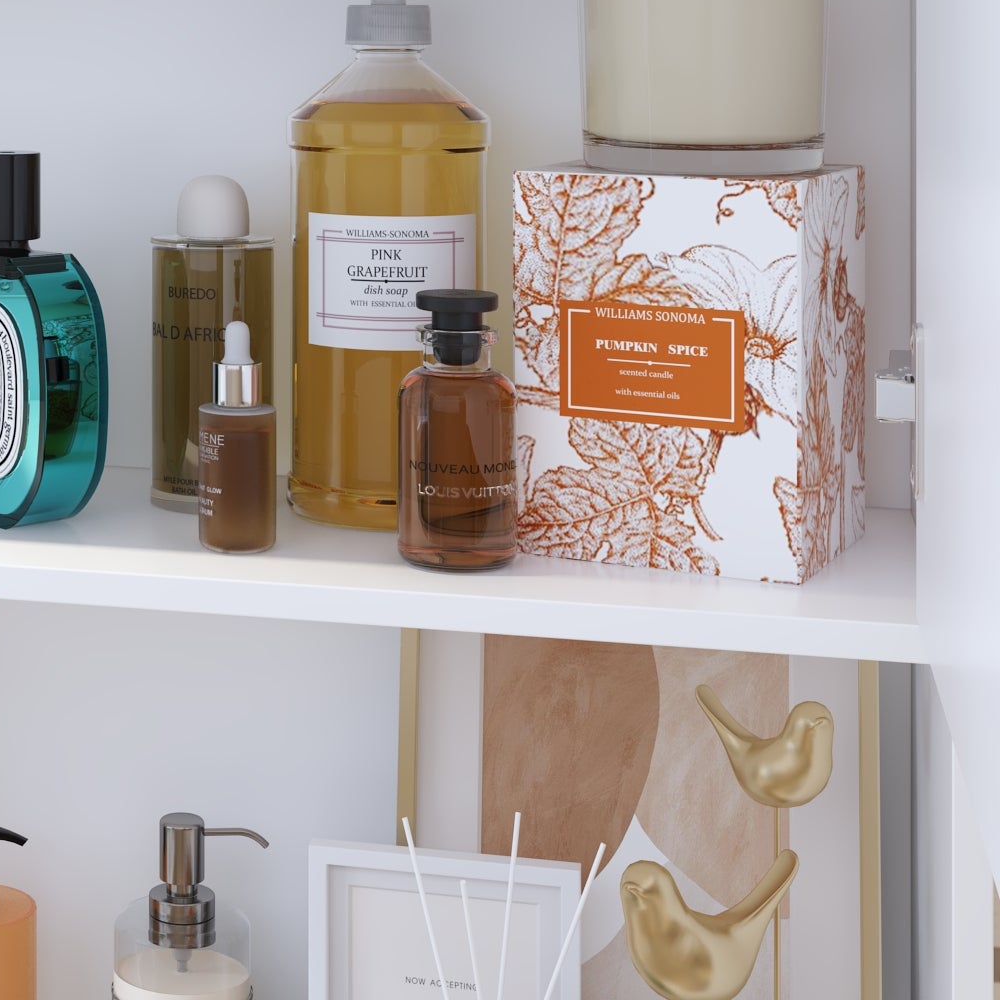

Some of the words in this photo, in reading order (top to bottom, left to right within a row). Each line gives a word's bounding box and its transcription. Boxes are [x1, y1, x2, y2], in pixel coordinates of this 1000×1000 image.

[345, 228, 430, 239] WILLIAMS-SONOMA
[371, 249, 403, 260] PINK
[347, 265, 428, 278] GRAPEFRUIT
[364, 285, 383, 295] dish
[386, 288, 408, 298] soap
[371, 300, 406, 308] ESSENTIAL
[595, 307, 653, 321] WILLIAMS
[655, 311, 706, 325] SONOMA
[152, 321, 168, 339] BAL
[170, 325, 180, 340] D
[595, 339, 658, 353] PUMPKIN
[668, 344, 709, 357] SPICE
[619, 368, 647, 377] scented
[648, 370, 674, 380] candle
[615, 387, 631, 396] with
[633, 389, 665, 399] essential
[666, 391, 680, 400] oils
[6, 393, 15, 420] saint
[409, 460, 479, 474] NOUVEAU
[484, 460, 517, 474] MOND
[418, 483, 459, 498] LOUIS
[405, 976, 427, 986] NOW
